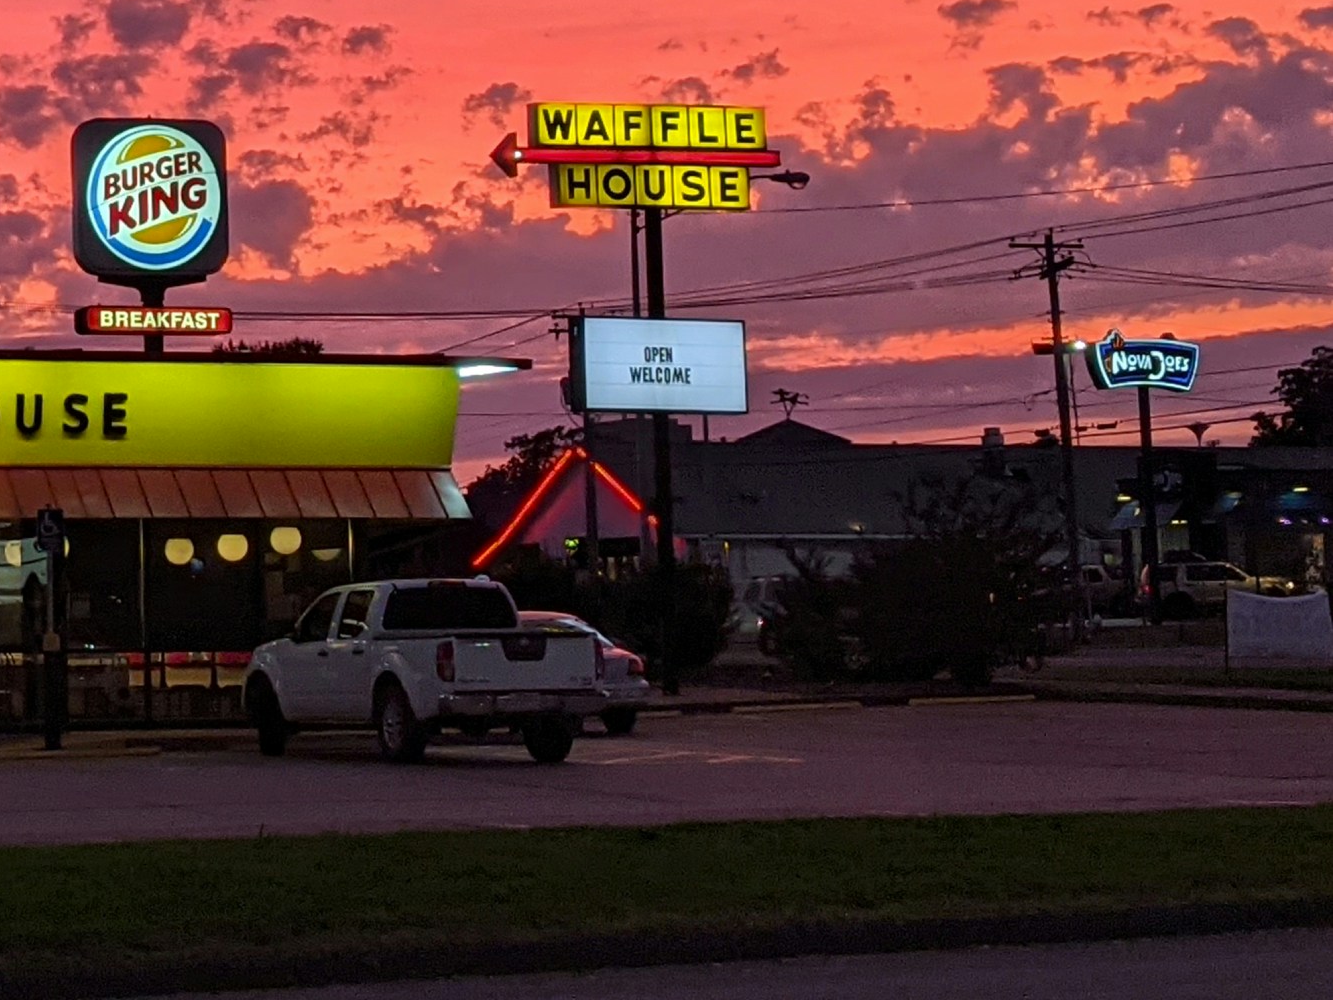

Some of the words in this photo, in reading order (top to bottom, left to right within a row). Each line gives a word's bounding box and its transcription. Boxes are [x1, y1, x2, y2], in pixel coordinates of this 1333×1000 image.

[542, 108, 756, 143] WAFFLE
[104, 151, 202, 200] BURGER
[568, 166, 741, 202] HOUSE
[109, 177, 207, 236] KING
[100, 311, 219, 329] BREAKFAST
[644, 346, 673, 363] OPEN
[629, 366, 691, 384] WELCOME
